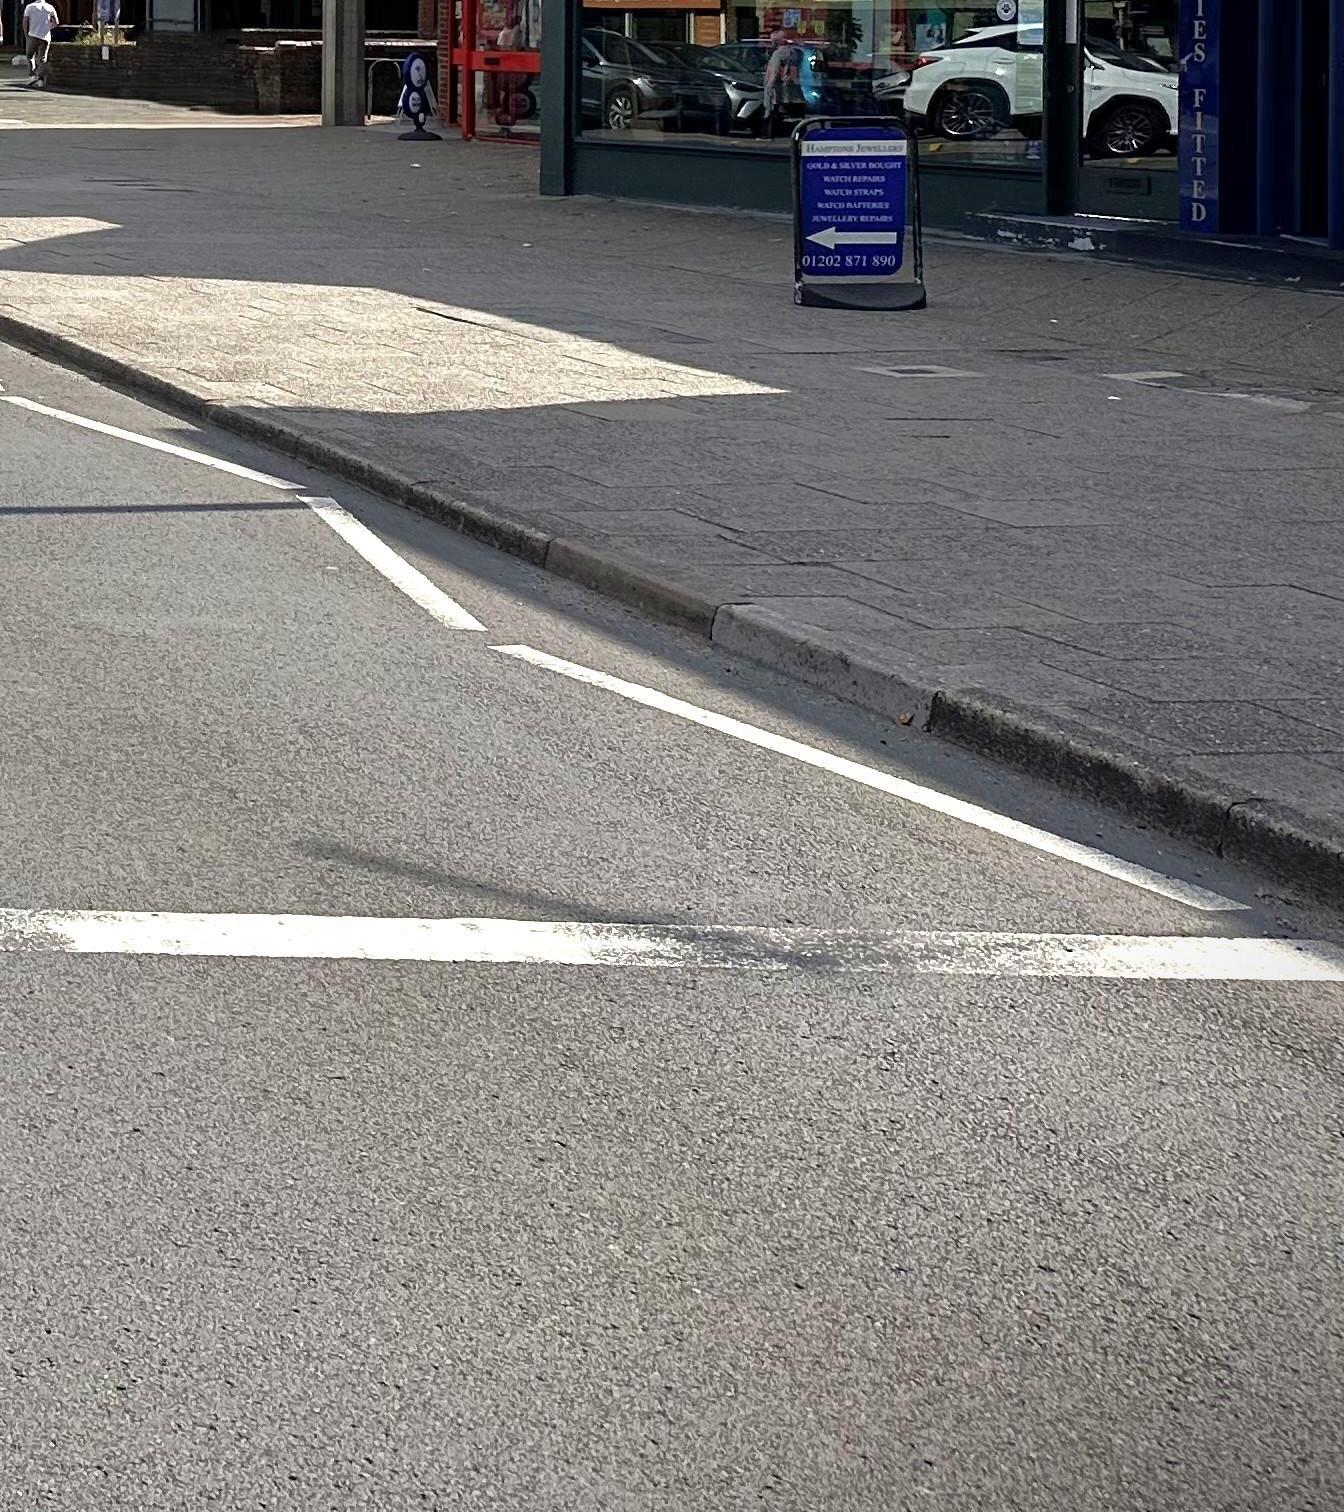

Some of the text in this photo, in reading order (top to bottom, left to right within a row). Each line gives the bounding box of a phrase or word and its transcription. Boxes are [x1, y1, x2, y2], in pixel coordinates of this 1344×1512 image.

[806, 143, 854, 153] HAMPTONS
[1191, 89, 1207, 222] FITTED
[807, 162, 830, 170] GOLD
[839, 162, 867, 170] SILVER
[869, 162, 902, 170] BOUGHT
[812, 215, 858, 223] JEWELLERY
[802, 255, 896, 267] 01202 871 890
